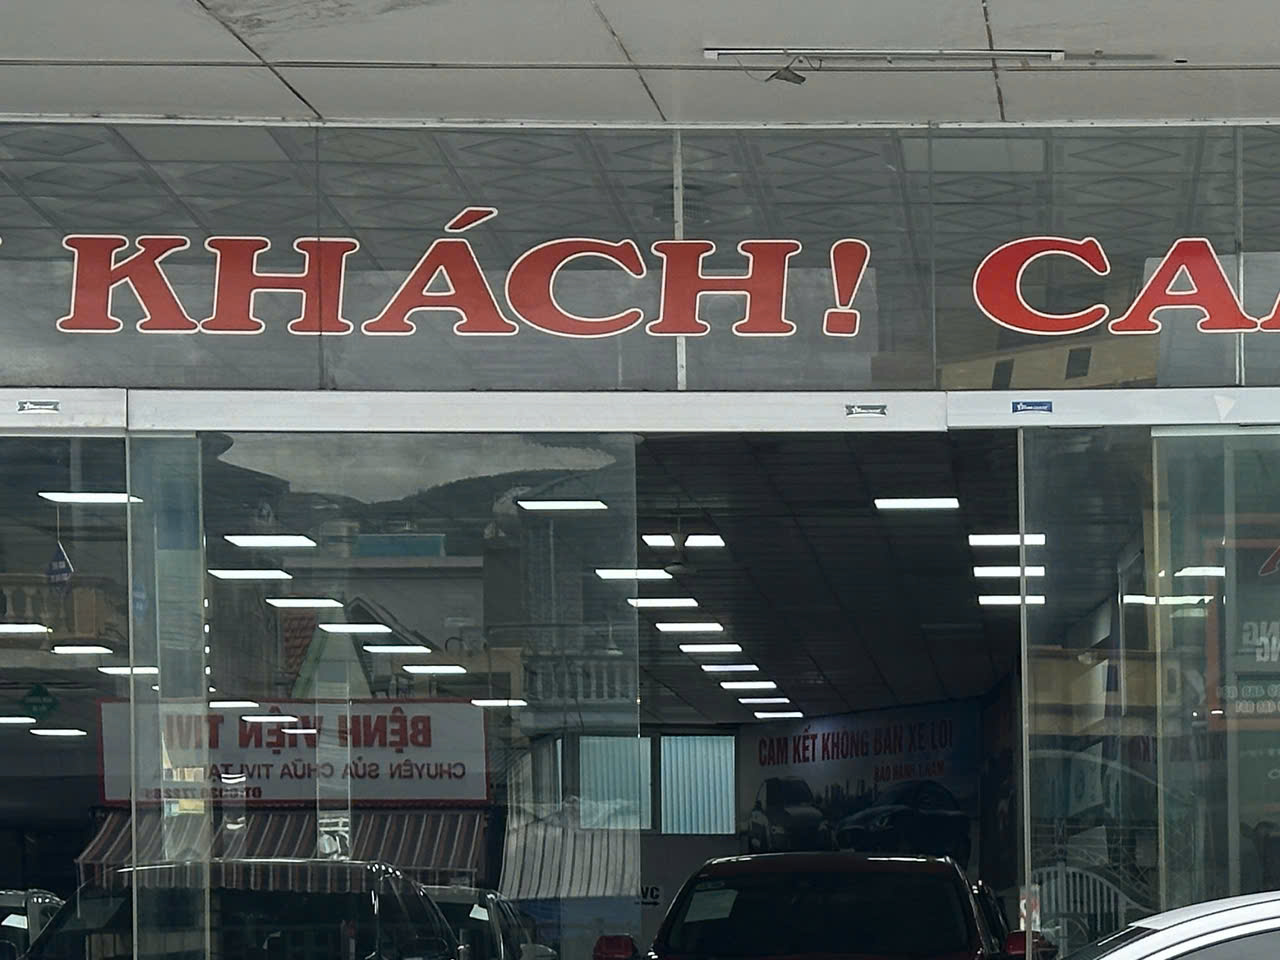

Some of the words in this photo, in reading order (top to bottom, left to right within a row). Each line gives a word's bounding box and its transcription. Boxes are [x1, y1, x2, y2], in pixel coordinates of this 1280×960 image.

[56, 206, 872, 339] KHÁCH!
[758, 735, 789, 767] CAM
[792, 725, 818, 764] KẾT
